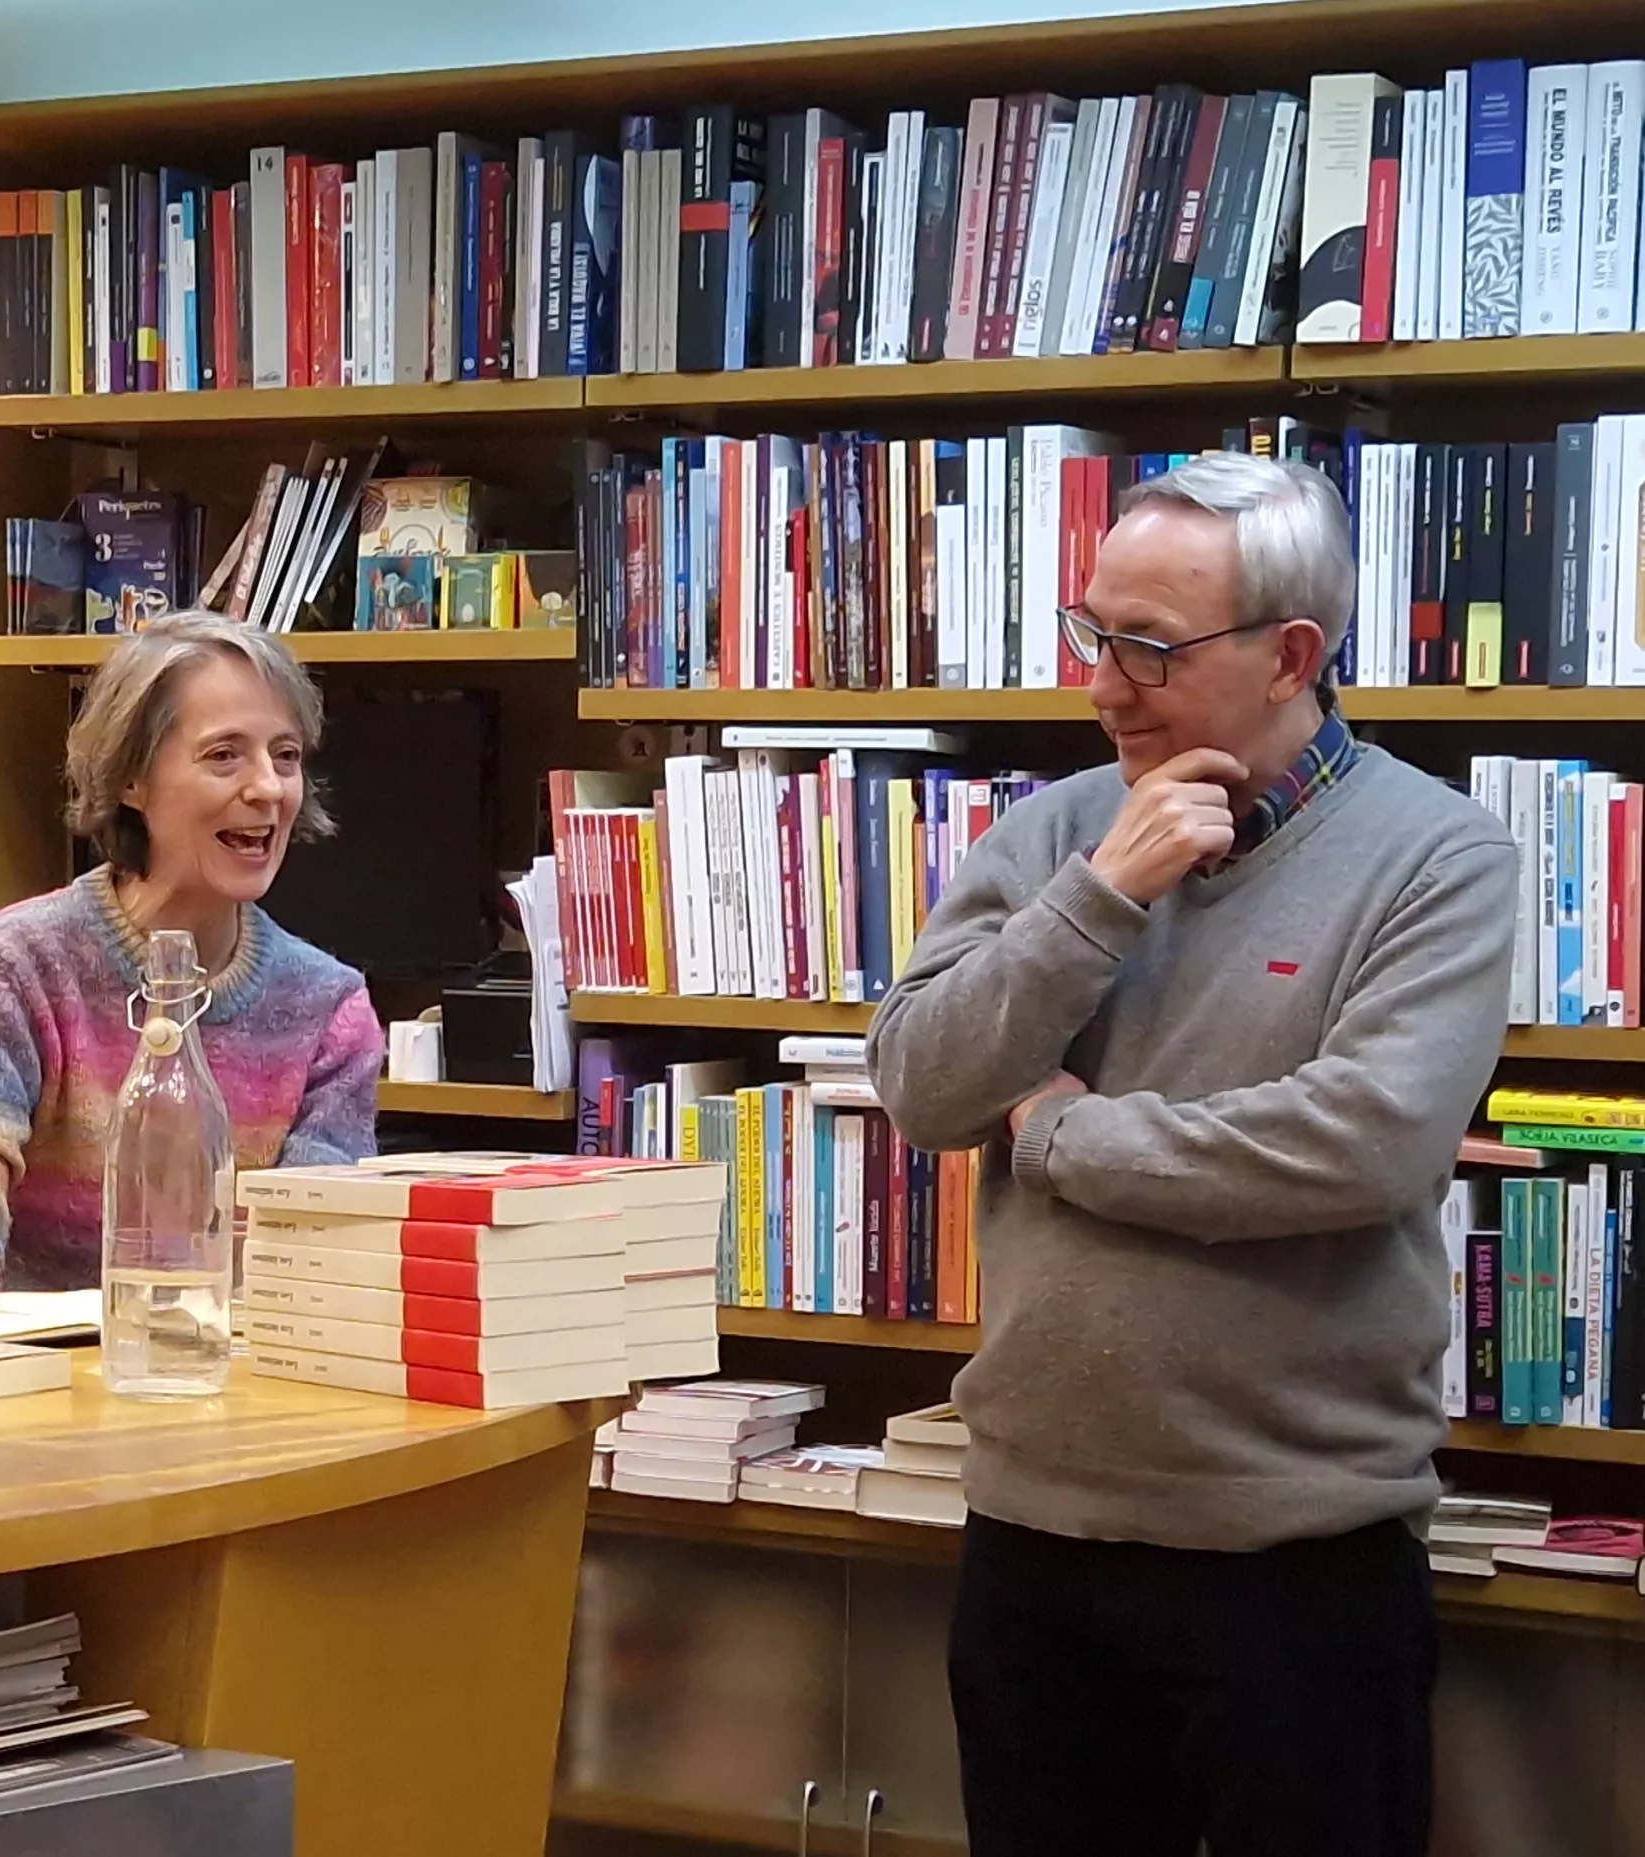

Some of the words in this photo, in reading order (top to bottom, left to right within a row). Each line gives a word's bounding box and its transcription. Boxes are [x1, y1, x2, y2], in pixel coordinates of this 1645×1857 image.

[1552, 88, 1567, 105] EL
[1550, 110, 1566, 162] MUNDO
[257, 156, 274, 171] 14
[1548, 167, 1564, 184] AL
[1546, 189, 1566, 234] REVÉS
[94, 532, 114, 562] 3
[1589, 1247, 1603, 1268] LA
[1588, 1271, 1601, 1315] DIETA
[1586, 1319, 1601, 1381] PEGANA
